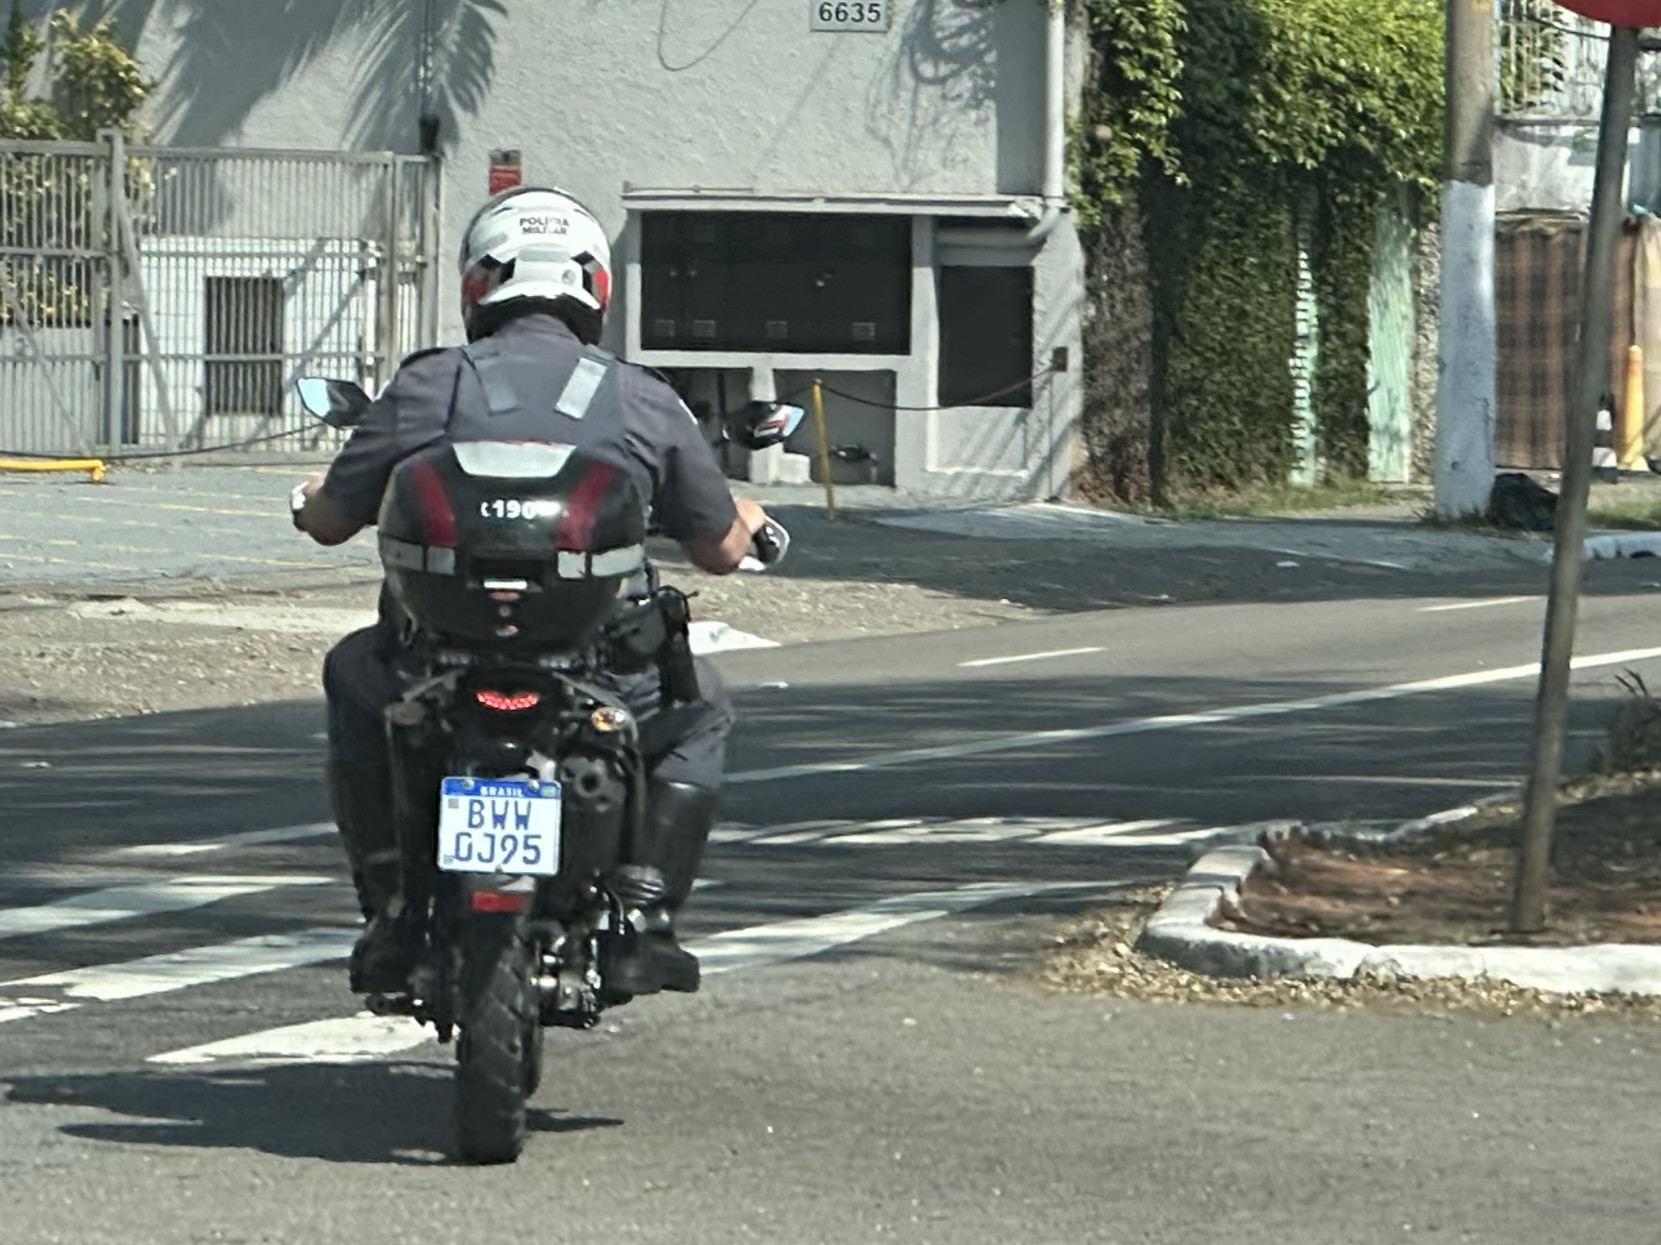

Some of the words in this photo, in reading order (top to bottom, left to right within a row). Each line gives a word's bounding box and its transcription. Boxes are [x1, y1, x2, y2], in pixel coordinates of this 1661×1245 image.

[819, 2, 881, 23] 6635
[522, 226, 567, 235] MILIAR
[492, 499, 537, 520] 190
[480, 786, 524, 797] BRASIL
[468, 799, 531, 830] BWW
